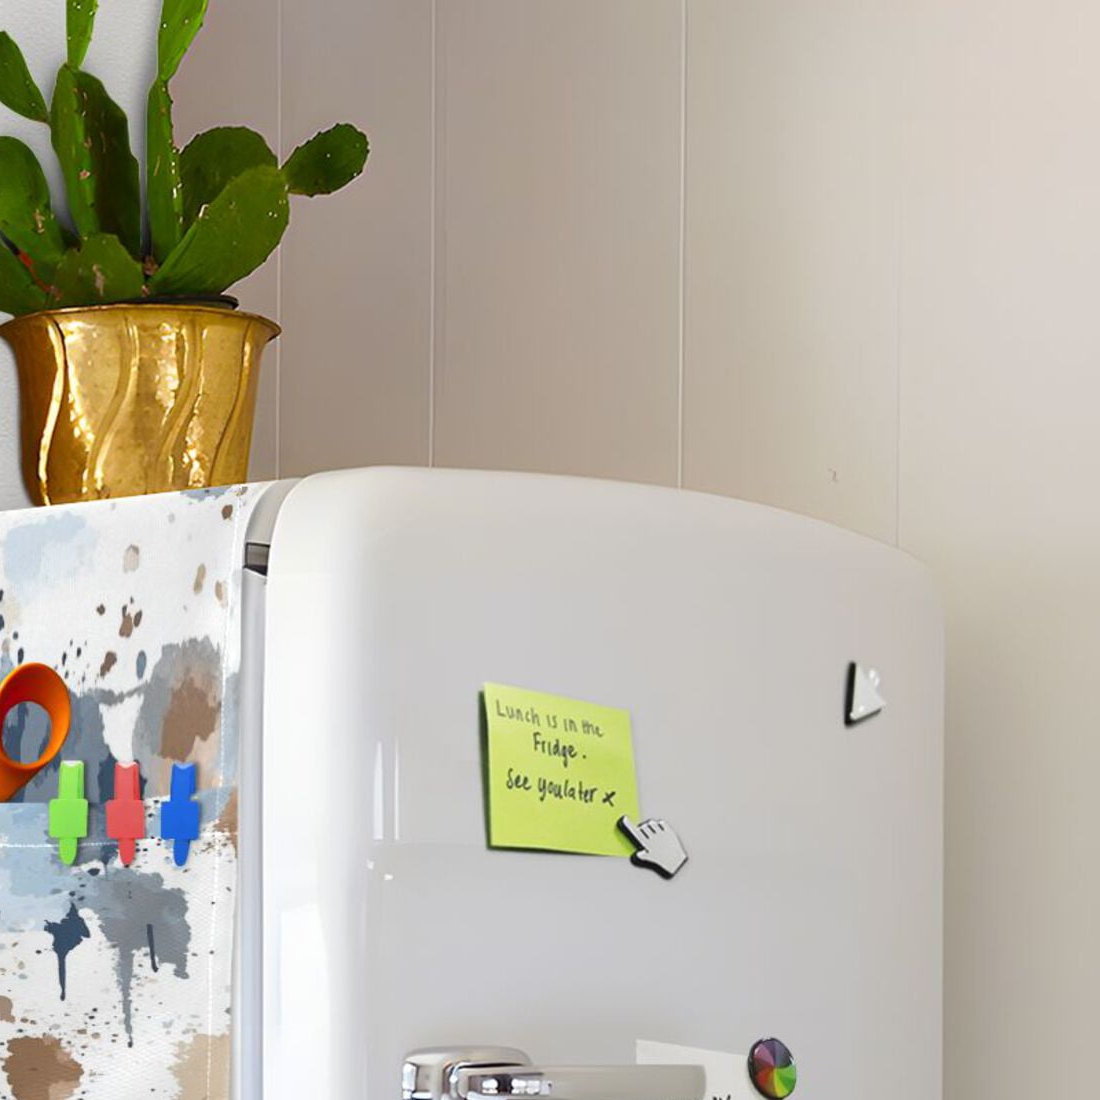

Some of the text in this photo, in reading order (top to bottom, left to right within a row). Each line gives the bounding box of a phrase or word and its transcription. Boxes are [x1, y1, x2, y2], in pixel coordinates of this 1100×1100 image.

[496, 699, 604, 738] Lunch is in the
[506, 767, 532, 791] See
